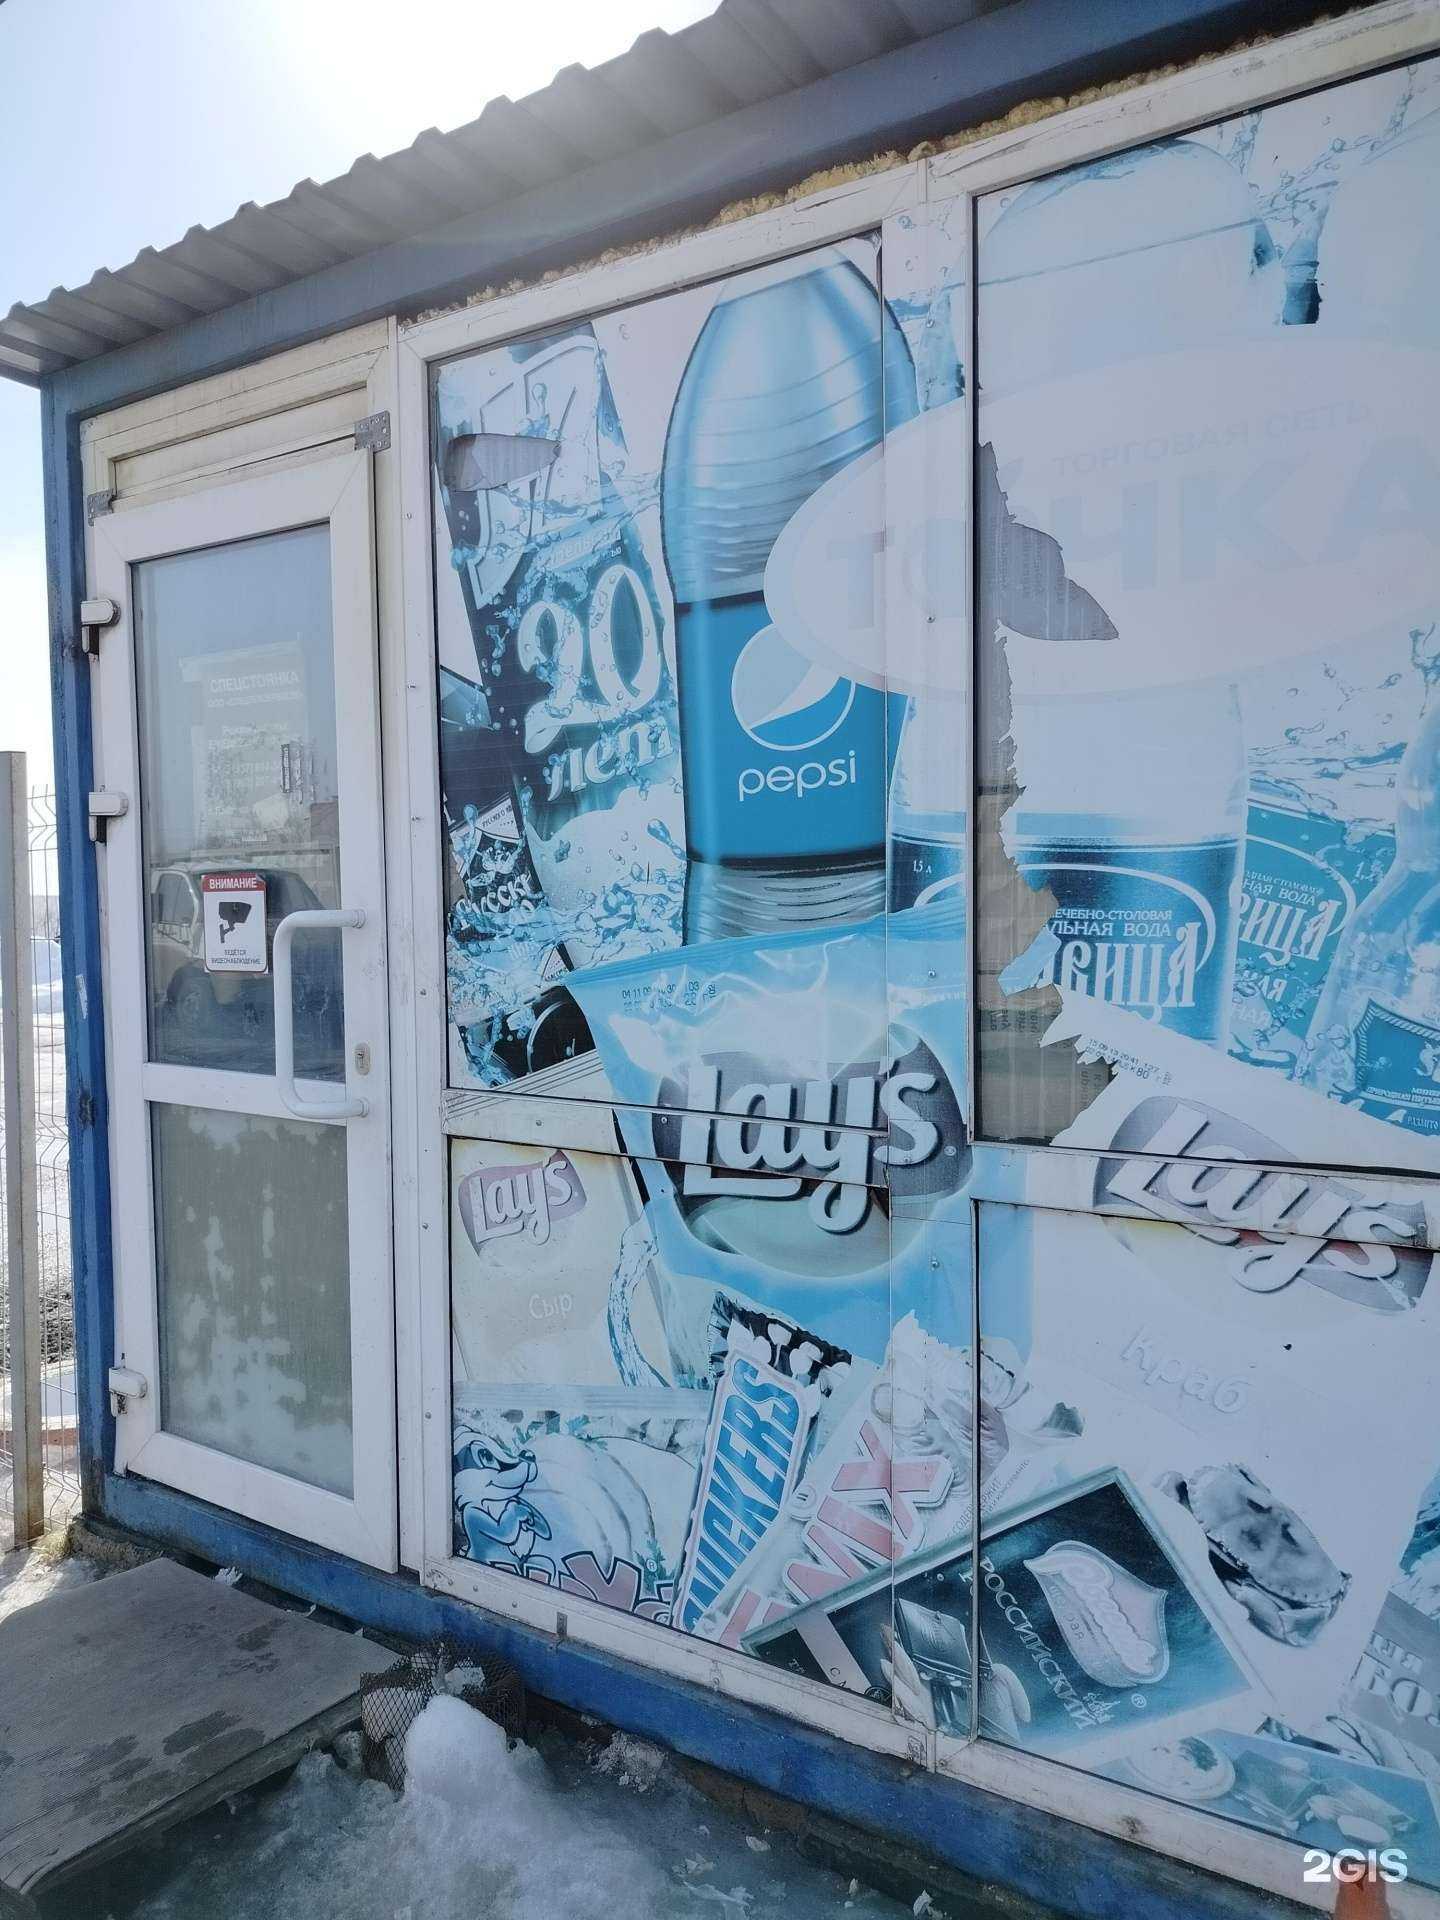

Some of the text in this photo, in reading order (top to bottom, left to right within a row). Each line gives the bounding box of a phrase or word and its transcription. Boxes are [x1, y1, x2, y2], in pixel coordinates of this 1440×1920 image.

[738, 750, 857, 802] pepsi
[209, 877, 257, 890] ВНИМАНИЕ
[1122, 921, 1172, 938] ВОДА
[529, 1293, 573, 1319] Сыр
[1119, 1327, 1256, 1414] Краб
[682, 1358, 800, 1633] SNICKERS
